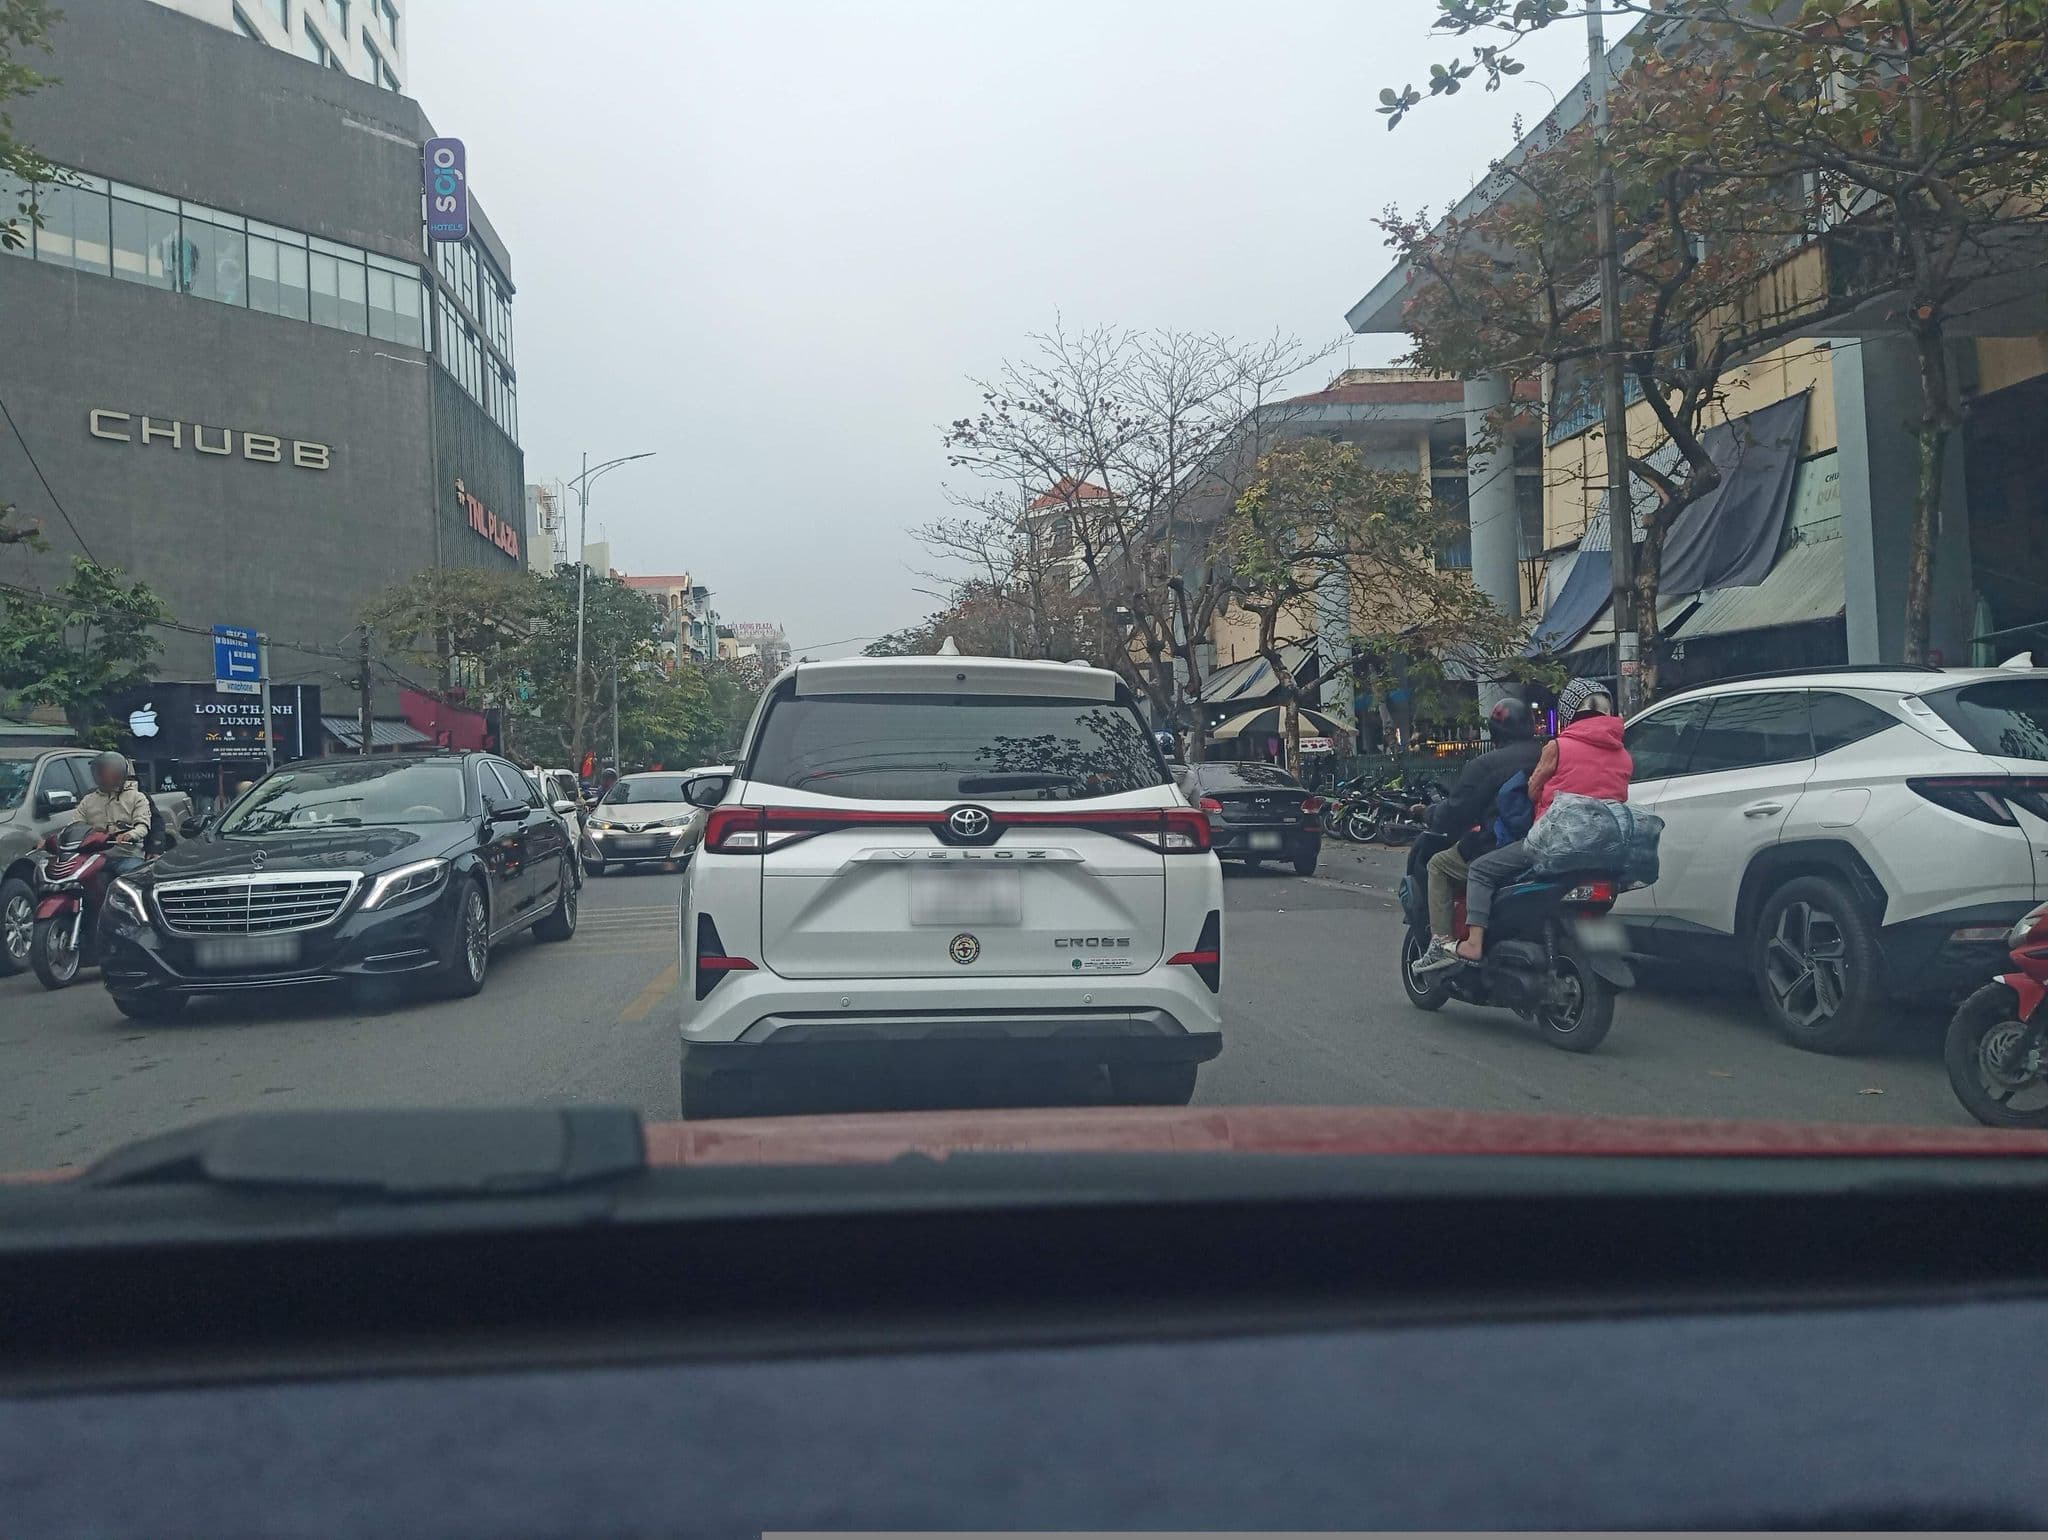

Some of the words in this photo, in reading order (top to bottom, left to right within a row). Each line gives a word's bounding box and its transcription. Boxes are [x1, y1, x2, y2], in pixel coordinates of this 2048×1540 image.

[431, 223, 464, 231] HOTELS
[90, 408, 330, 470] CHUBB
[195, 704, 238, 714] LONG
[240, 705, 293, 715] THNH
[220, 717, 265, 725] LUXUR
[892, 850, 1047, 859] VELOZ
[1054, 937, 1131, 948] CROSS
